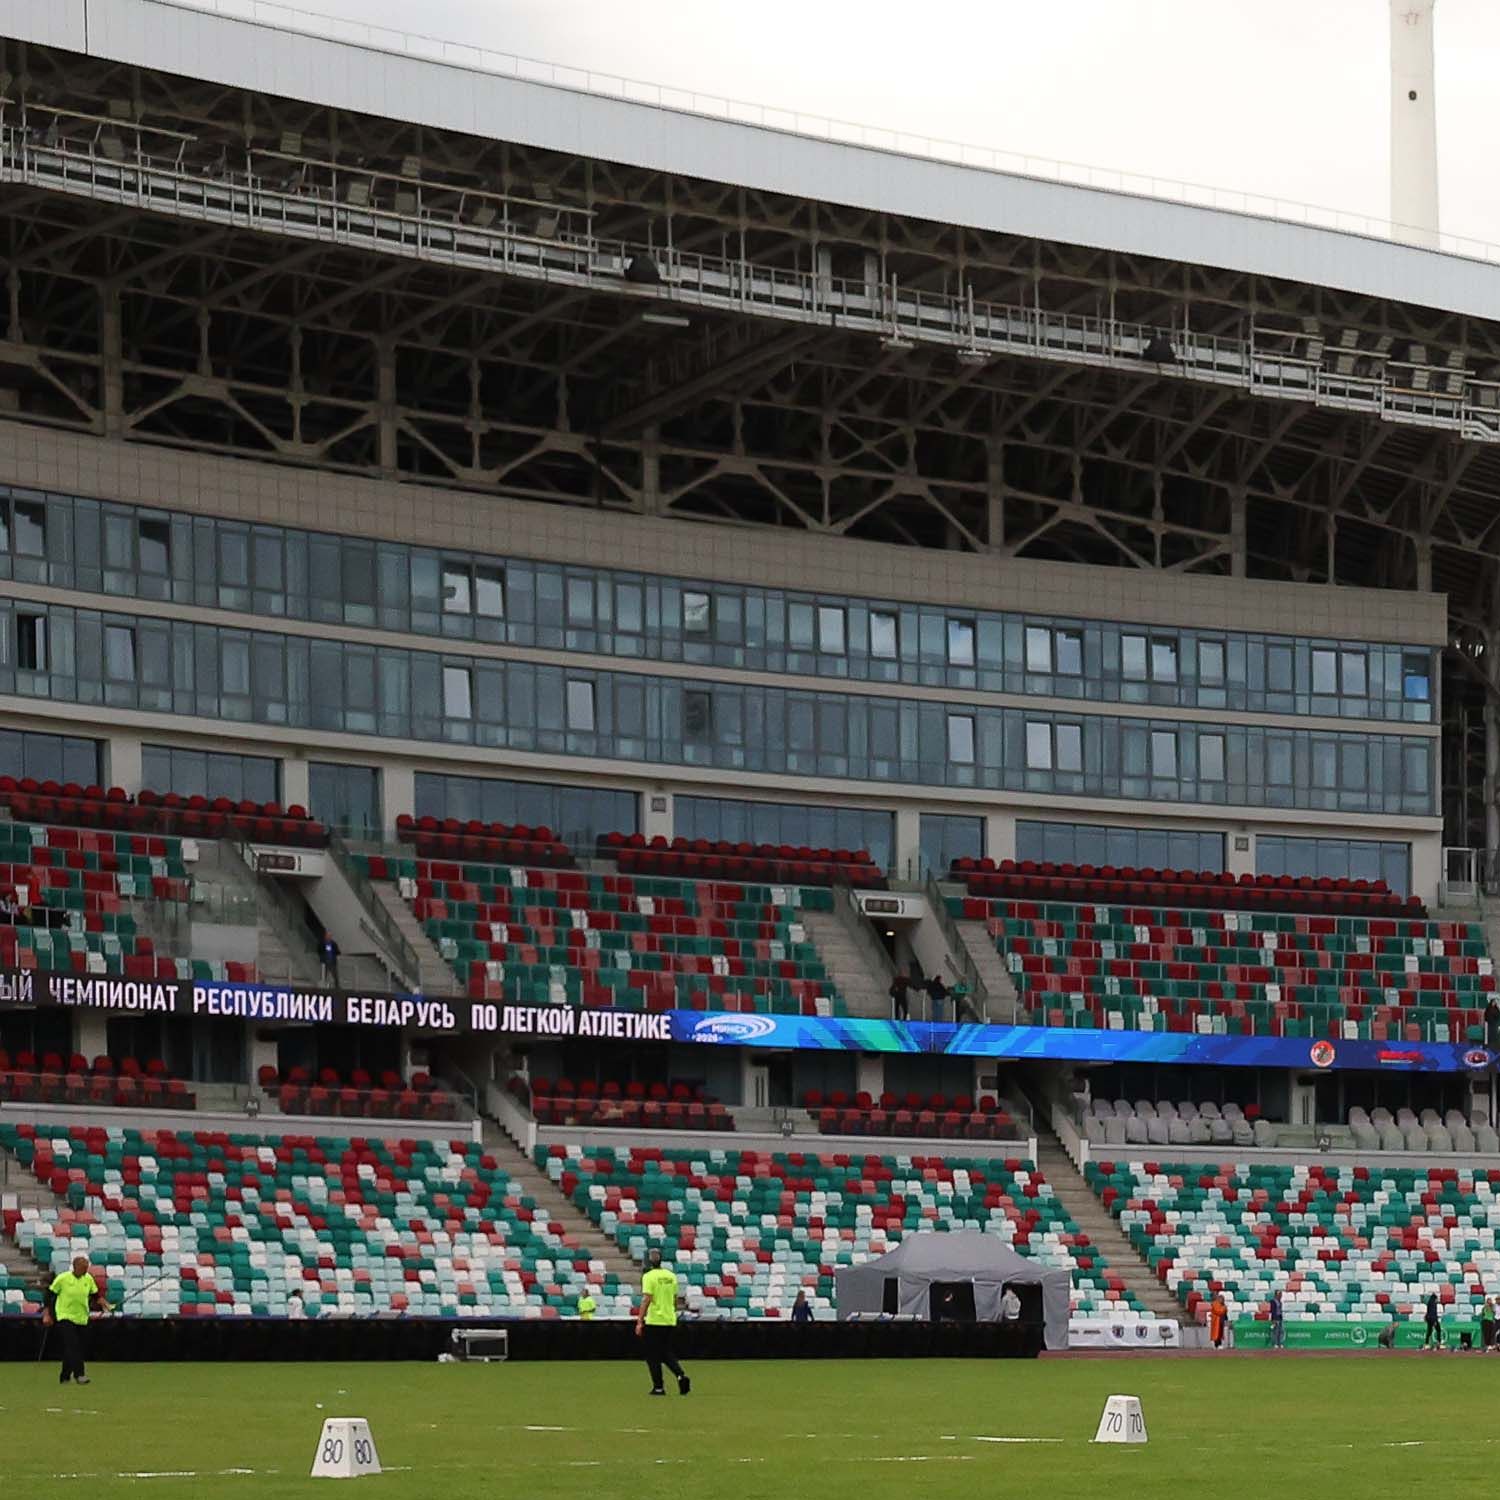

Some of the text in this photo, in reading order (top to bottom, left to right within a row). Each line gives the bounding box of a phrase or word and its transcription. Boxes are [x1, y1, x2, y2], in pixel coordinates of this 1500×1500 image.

[49, 978, 179, 1012] ЧЕМПИОНАТ
[193, 988, 332, 1020] РЕСПУБЛИКИ
[347, 997, 455, 1029] БЕЛАРУСЬ
[472, 1008, 498, 1031] ПО
[500, 1005, 574, 1034] ЛЕГКОЙ
[578, 1010, 672, 1040] АТЛЕТИКЕ
[1106, 1412, 1122, 1432] 70
[1130, 1413, 1142, 1433] 70
[322, 1438, 344, 1464] 80
[354, 1440, 372, 1464] 80
